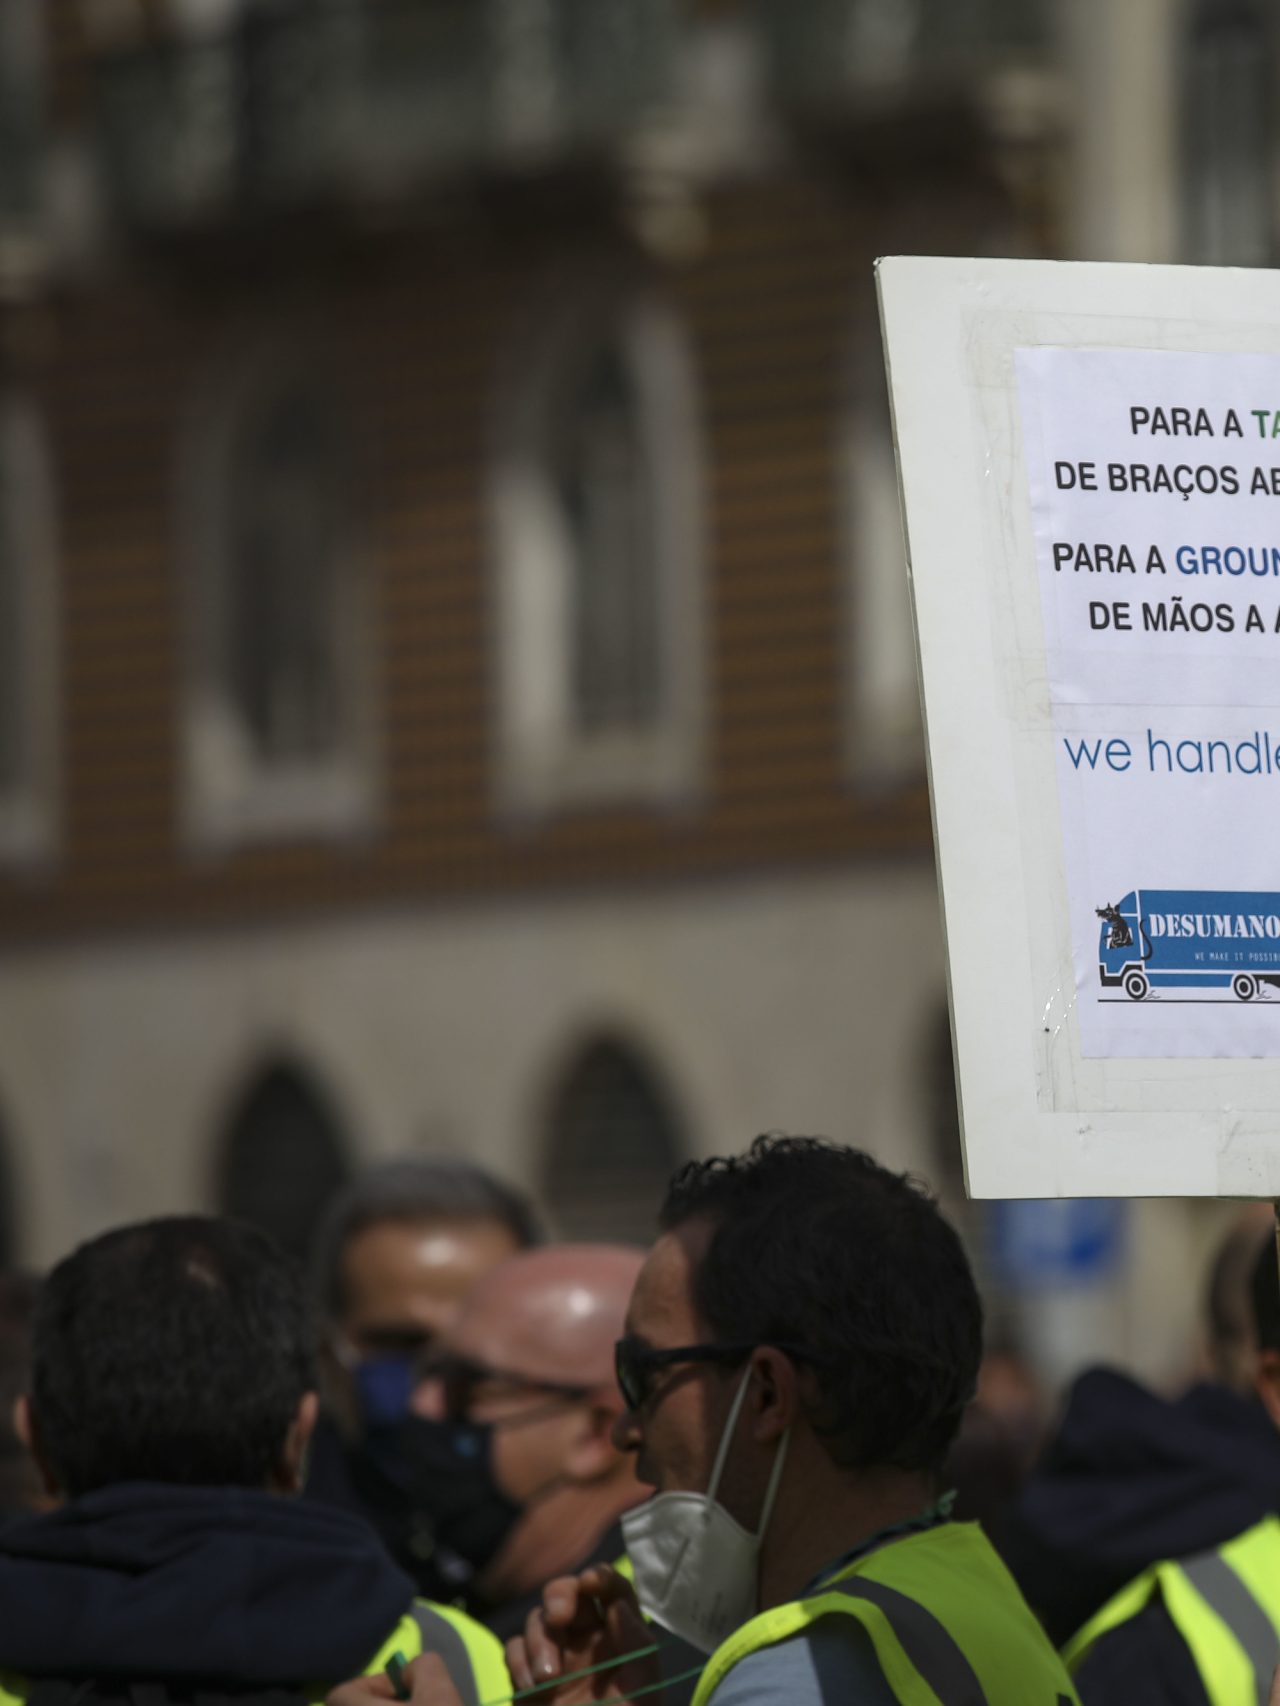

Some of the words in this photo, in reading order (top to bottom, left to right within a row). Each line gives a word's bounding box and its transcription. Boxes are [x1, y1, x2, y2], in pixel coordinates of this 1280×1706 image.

[1130, 406, 1214, 437] PARA
[1223, 408, 1244, 438] A
[1054, 461, 1098, 491] DE
[1108, 463, 1239, 501] BRAÇOS
[1052, 543, 1136, 574] PARA
[1145, 545, 1166, 574] A
[1089, 601, 1133, 631] DE
[1142, 596, 1235, 632] MÃOS
[1245, 604, 1265, 634] A
[1063, 738, 1132, 772] we
[1195, 951, 1205, 961] WE
[1209, 951, 1229, 961] MAKE
[1234, 952, 1244, 961] IT
